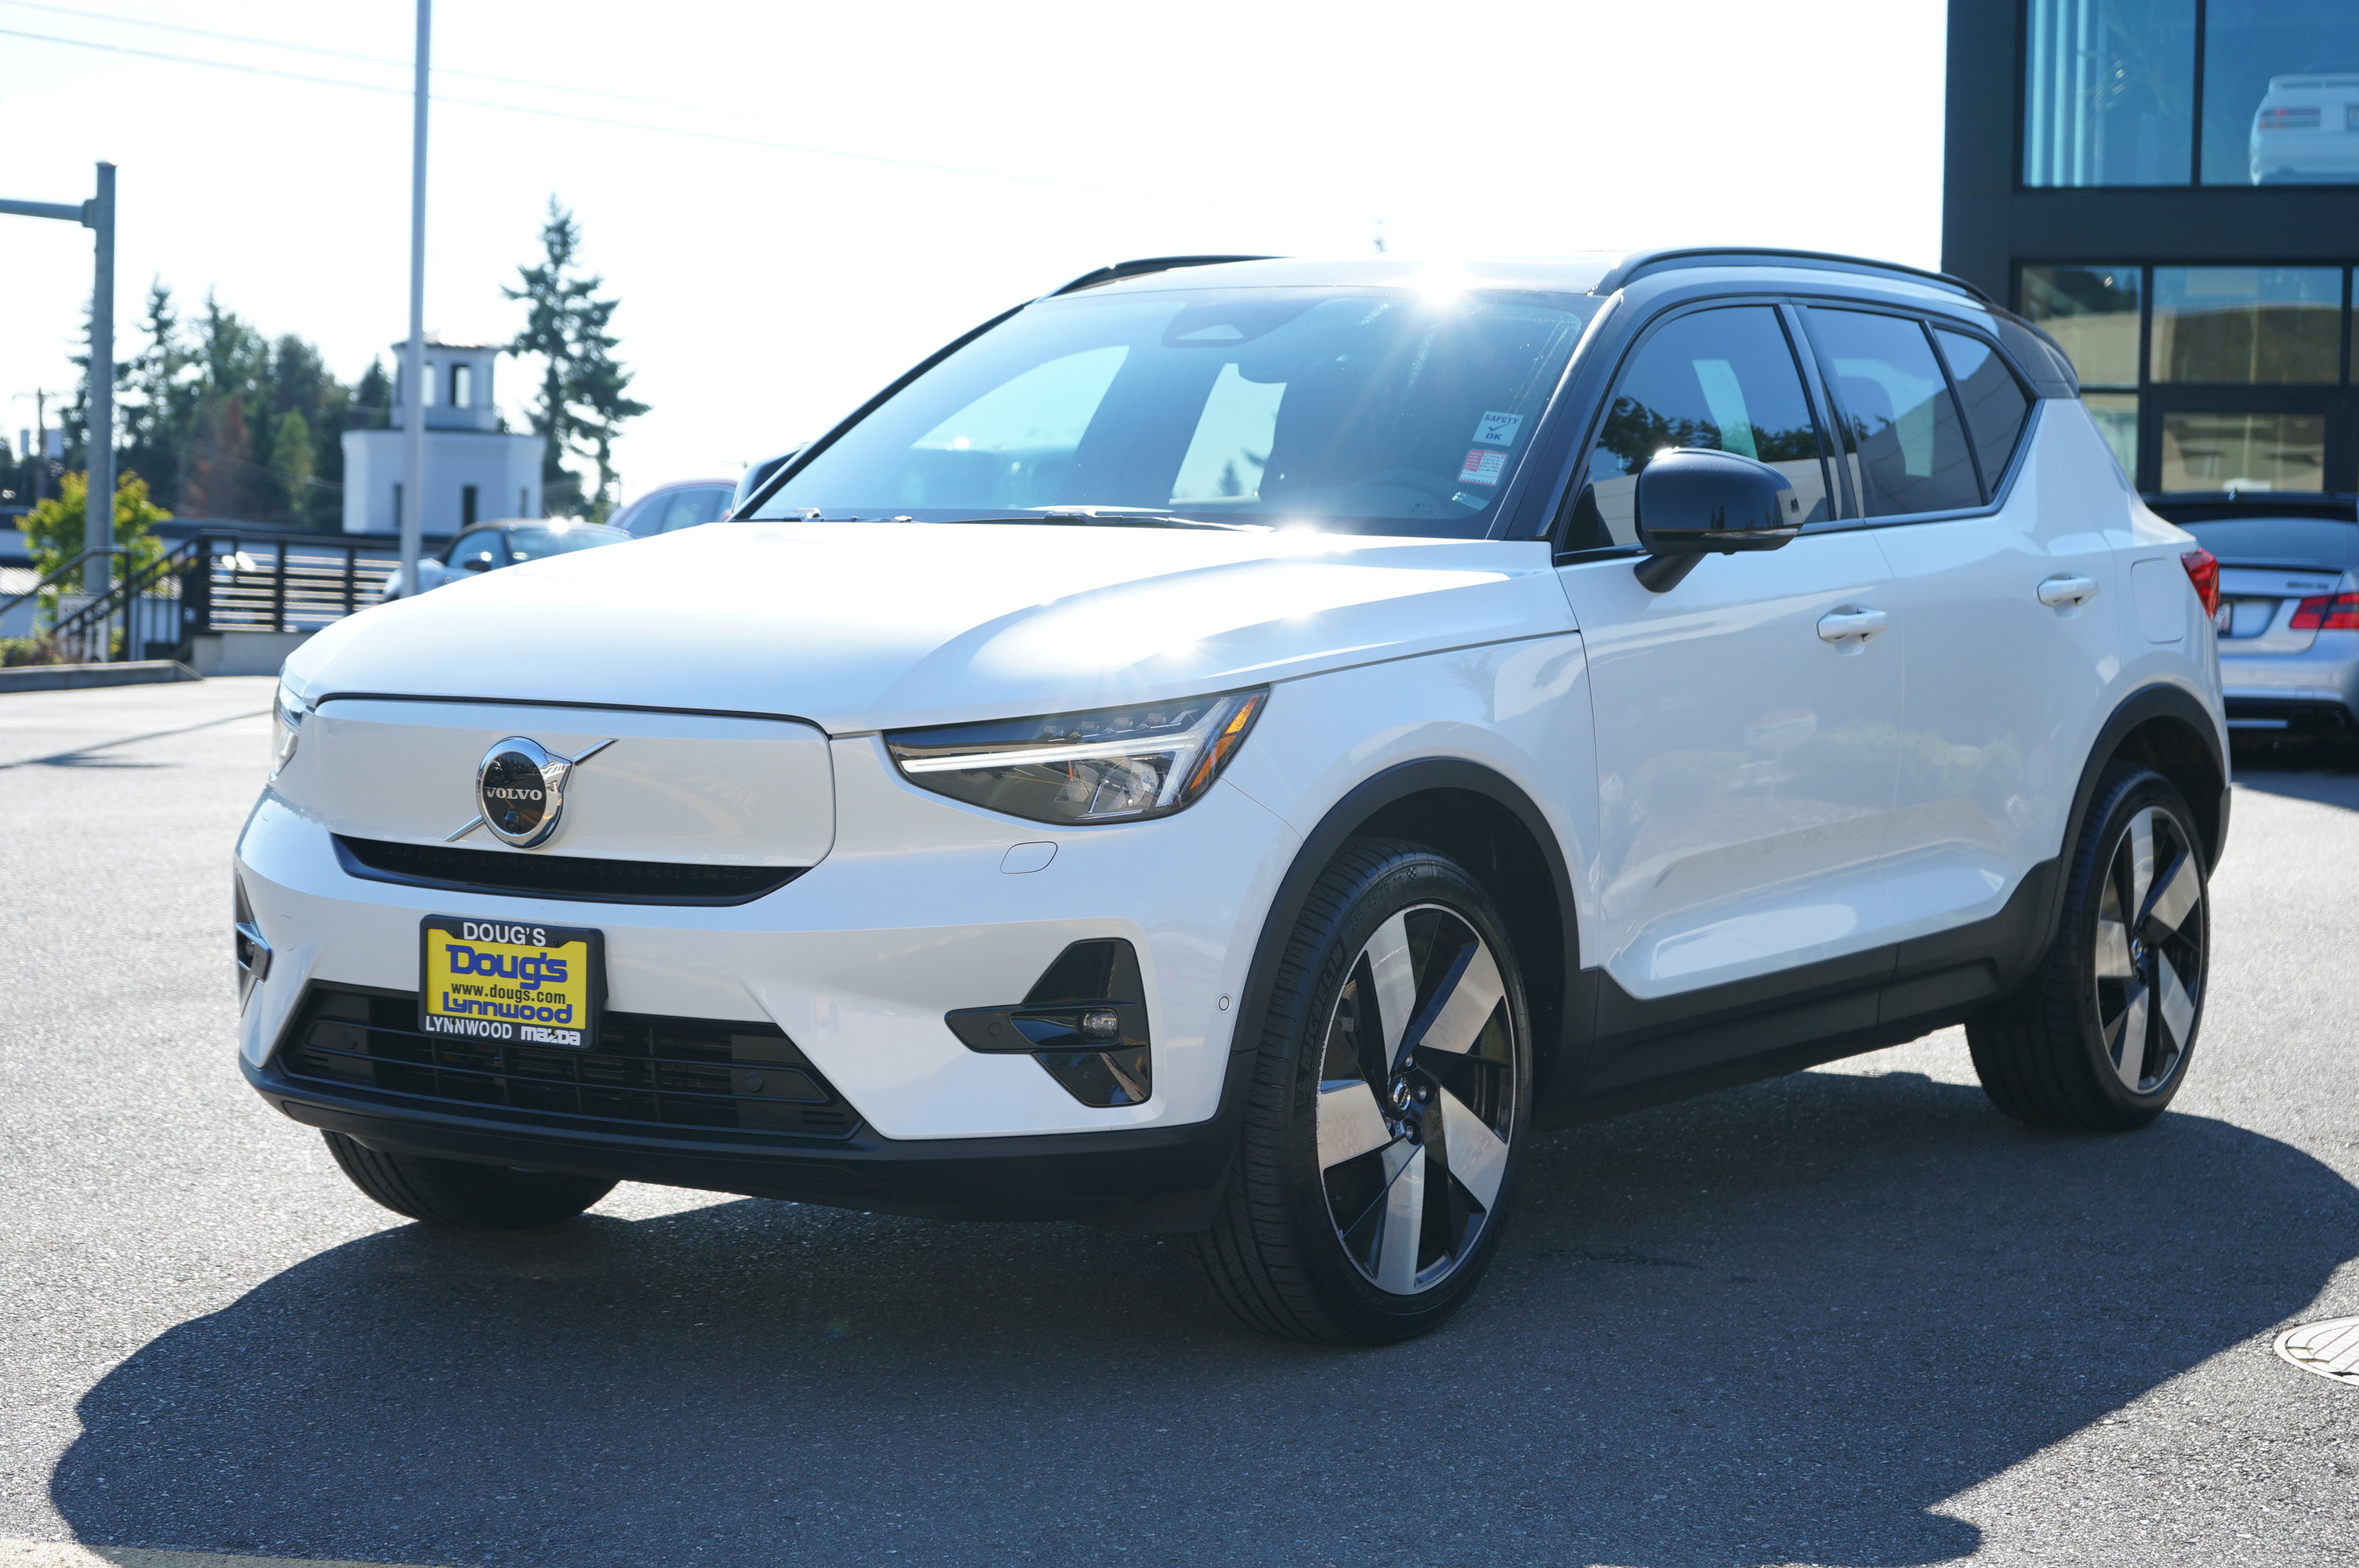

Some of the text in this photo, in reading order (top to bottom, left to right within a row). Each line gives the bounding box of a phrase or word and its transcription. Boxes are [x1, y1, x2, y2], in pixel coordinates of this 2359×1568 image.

[1485, 415, 1519, 424] SAFETY
[1485, 432, 1503, 441] OK
[485, 786, 543, 801] VOLVO
[463, 922, 547, 947] DOUG'S
[445, 944, 568, 990] Doug's
[451, 983, 566, 1004] www.dougs.com
[443, 992, 572, 1024] Lynnwood
[426, 1015, 512, 1039] LYNNWOOD
